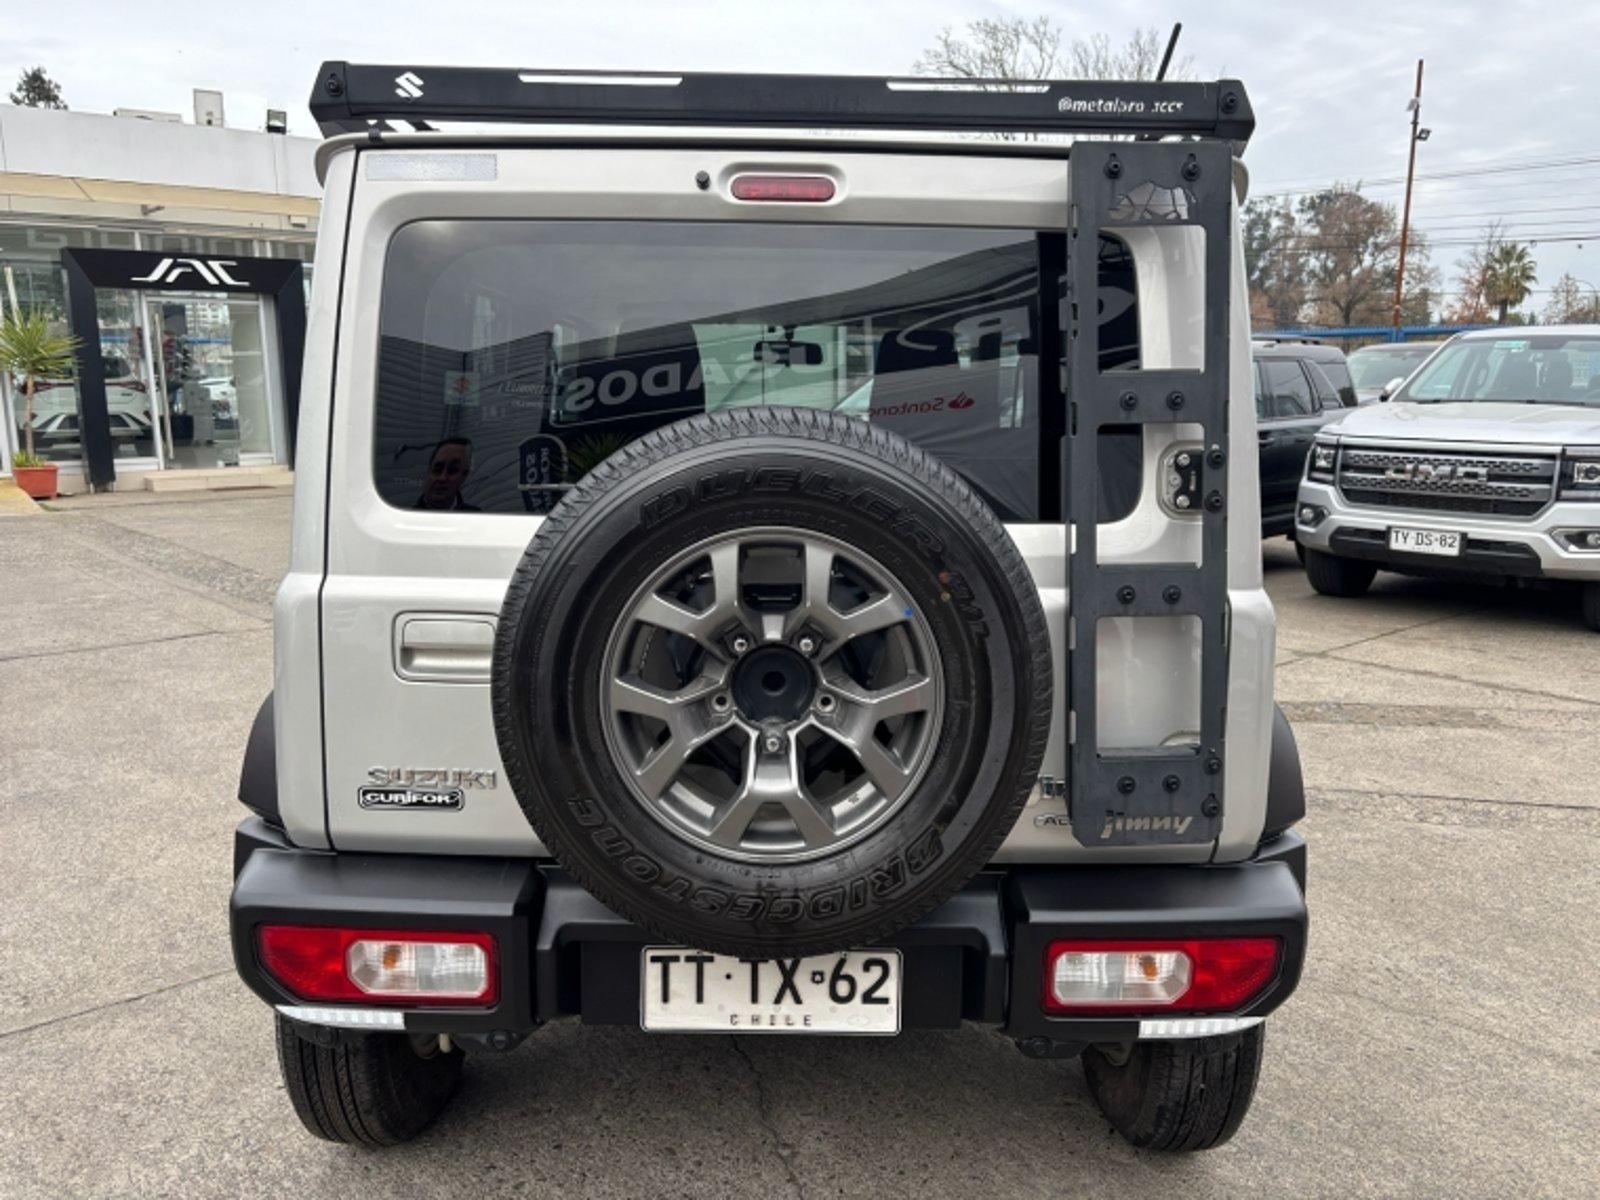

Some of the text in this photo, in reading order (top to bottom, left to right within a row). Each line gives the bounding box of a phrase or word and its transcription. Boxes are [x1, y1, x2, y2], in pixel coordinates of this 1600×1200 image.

[130, 257, 250, 286] JAC
[639, 465, 948, 556] DUELER
[367, 765, 498, 790] SUZUKI
[567, 796, 944, 924] BRIDGESTONE
[729, 1013, 812, 1027] CHILE
